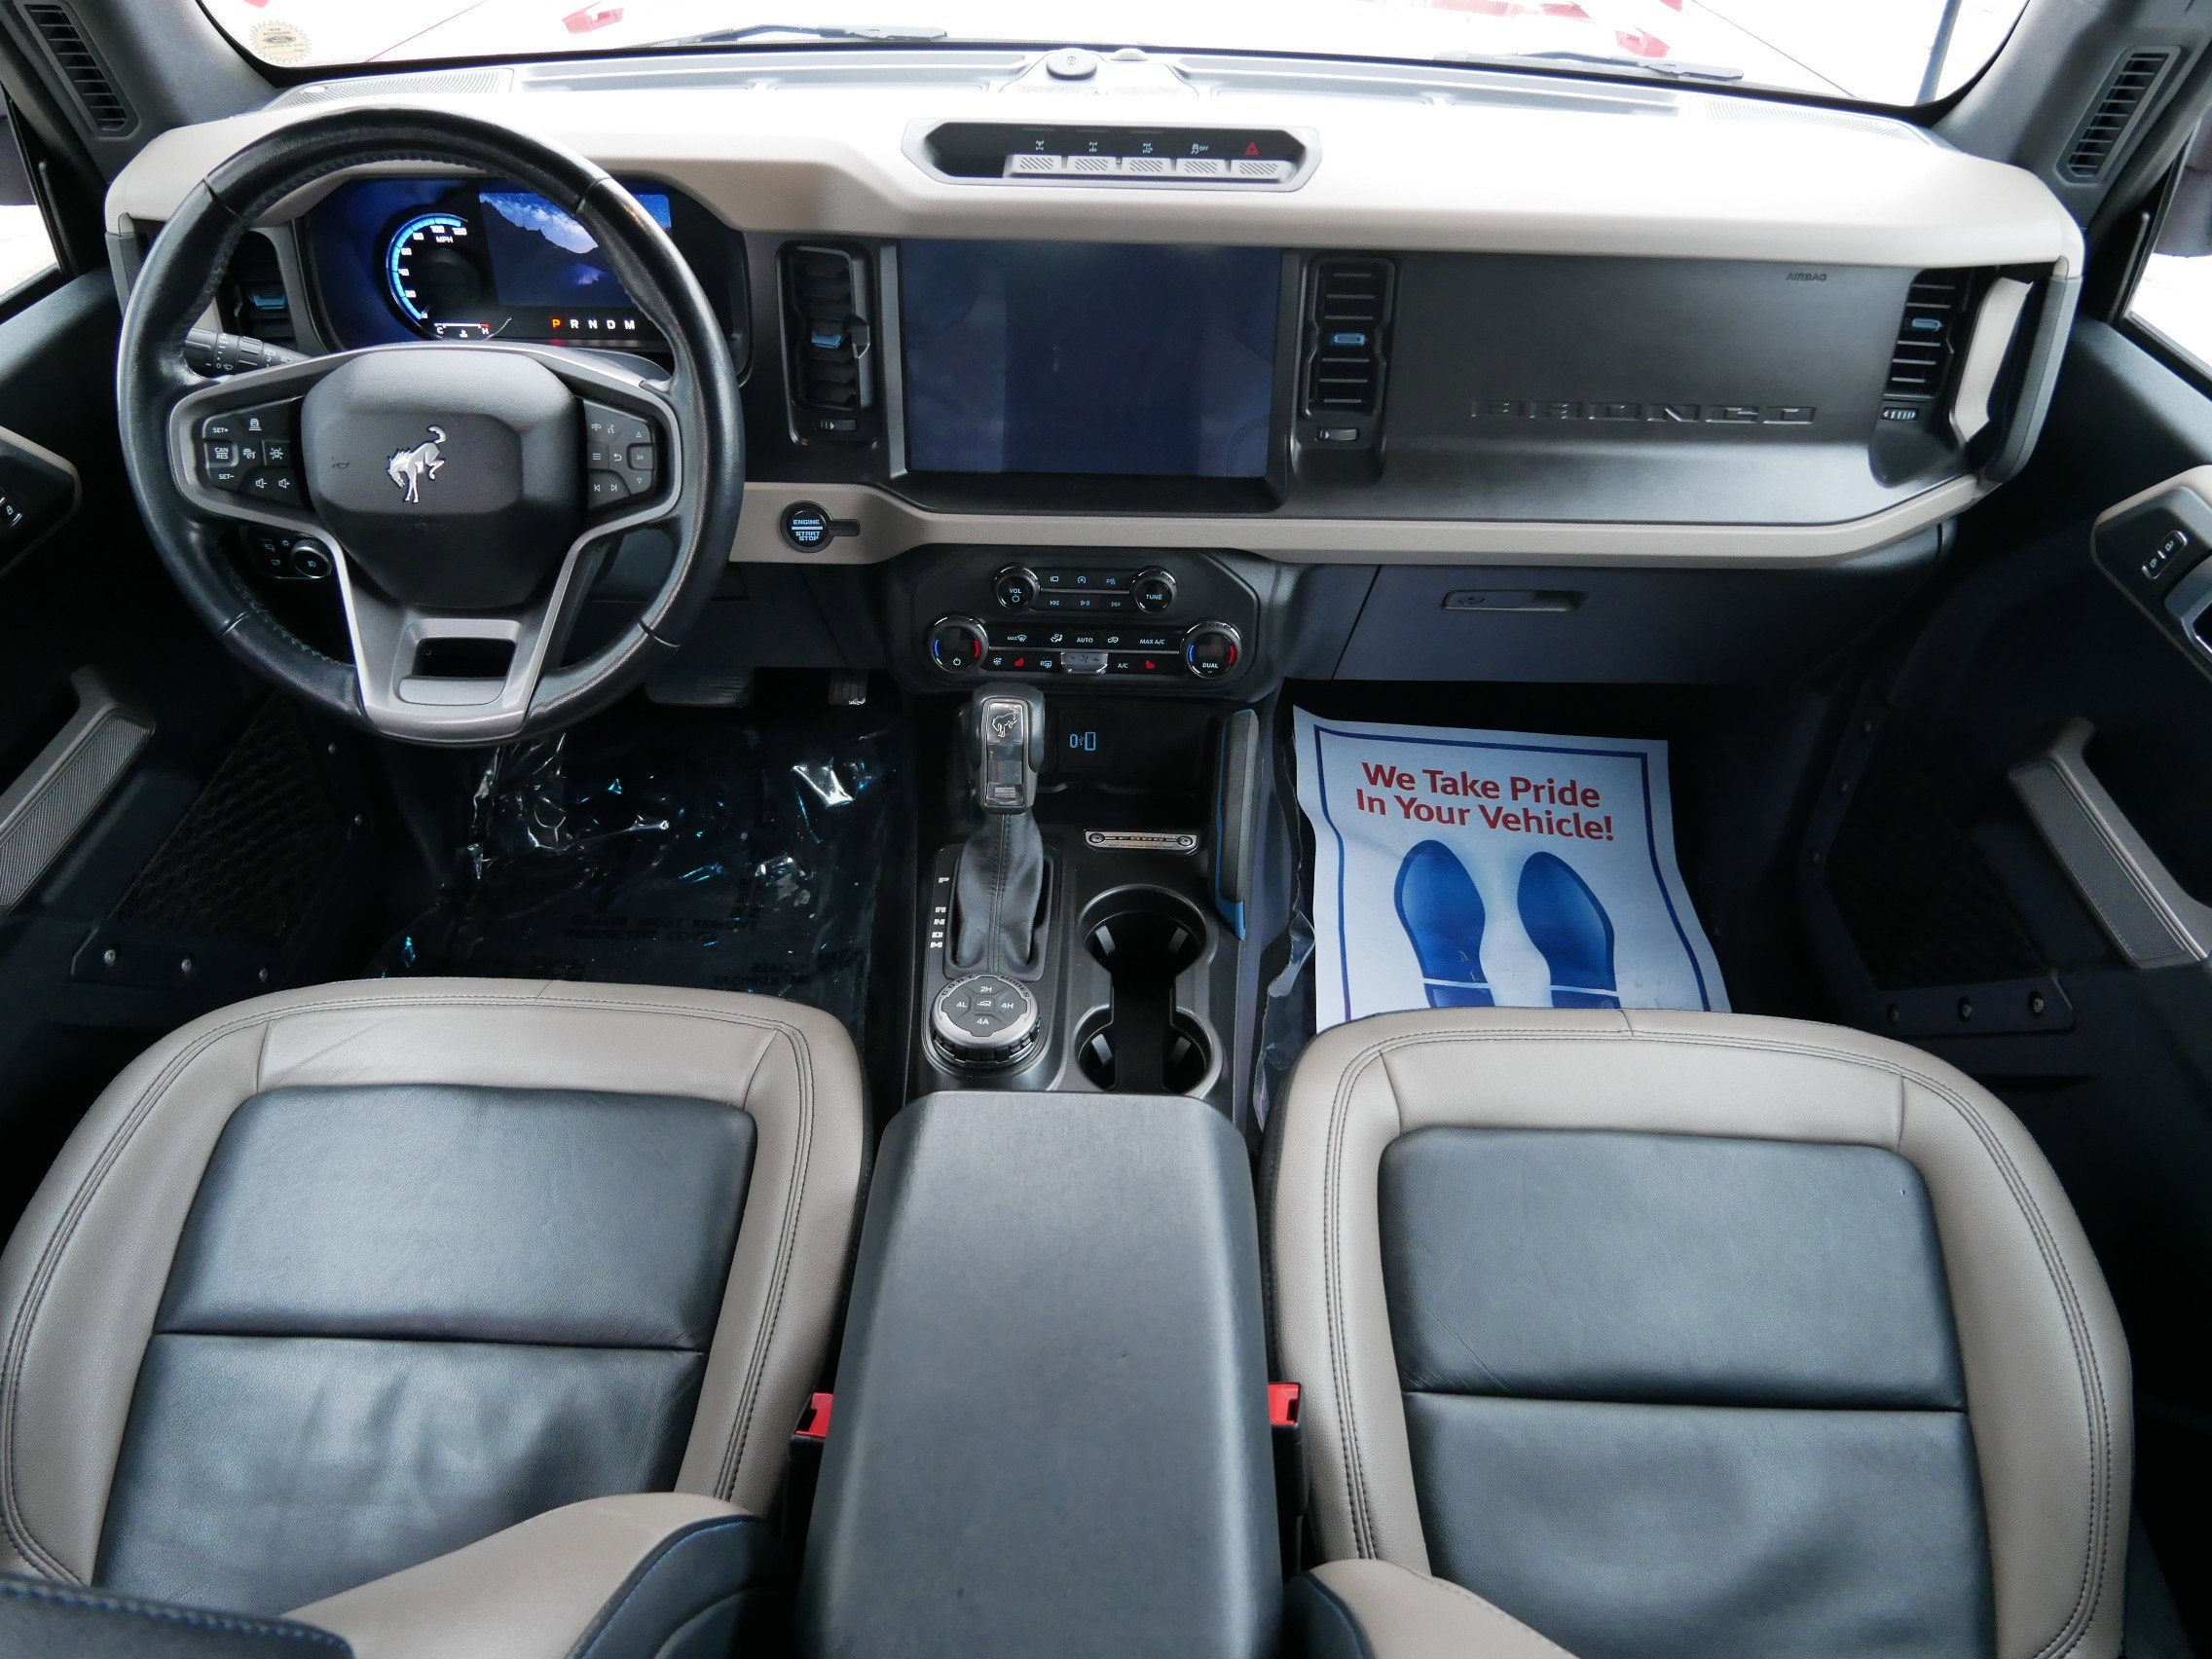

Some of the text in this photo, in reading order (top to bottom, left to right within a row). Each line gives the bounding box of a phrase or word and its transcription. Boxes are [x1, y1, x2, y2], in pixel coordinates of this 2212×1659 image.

[1785, 272, 1827, 281] AIRBAG
[551, 318, 636, 330] P R N D M
[1470, 398, 1816, 425] BRONCO
[1361, 761, 1601, 808] We Take Pride
[1356, 788, 1614, 841] In Your Vehicle!
